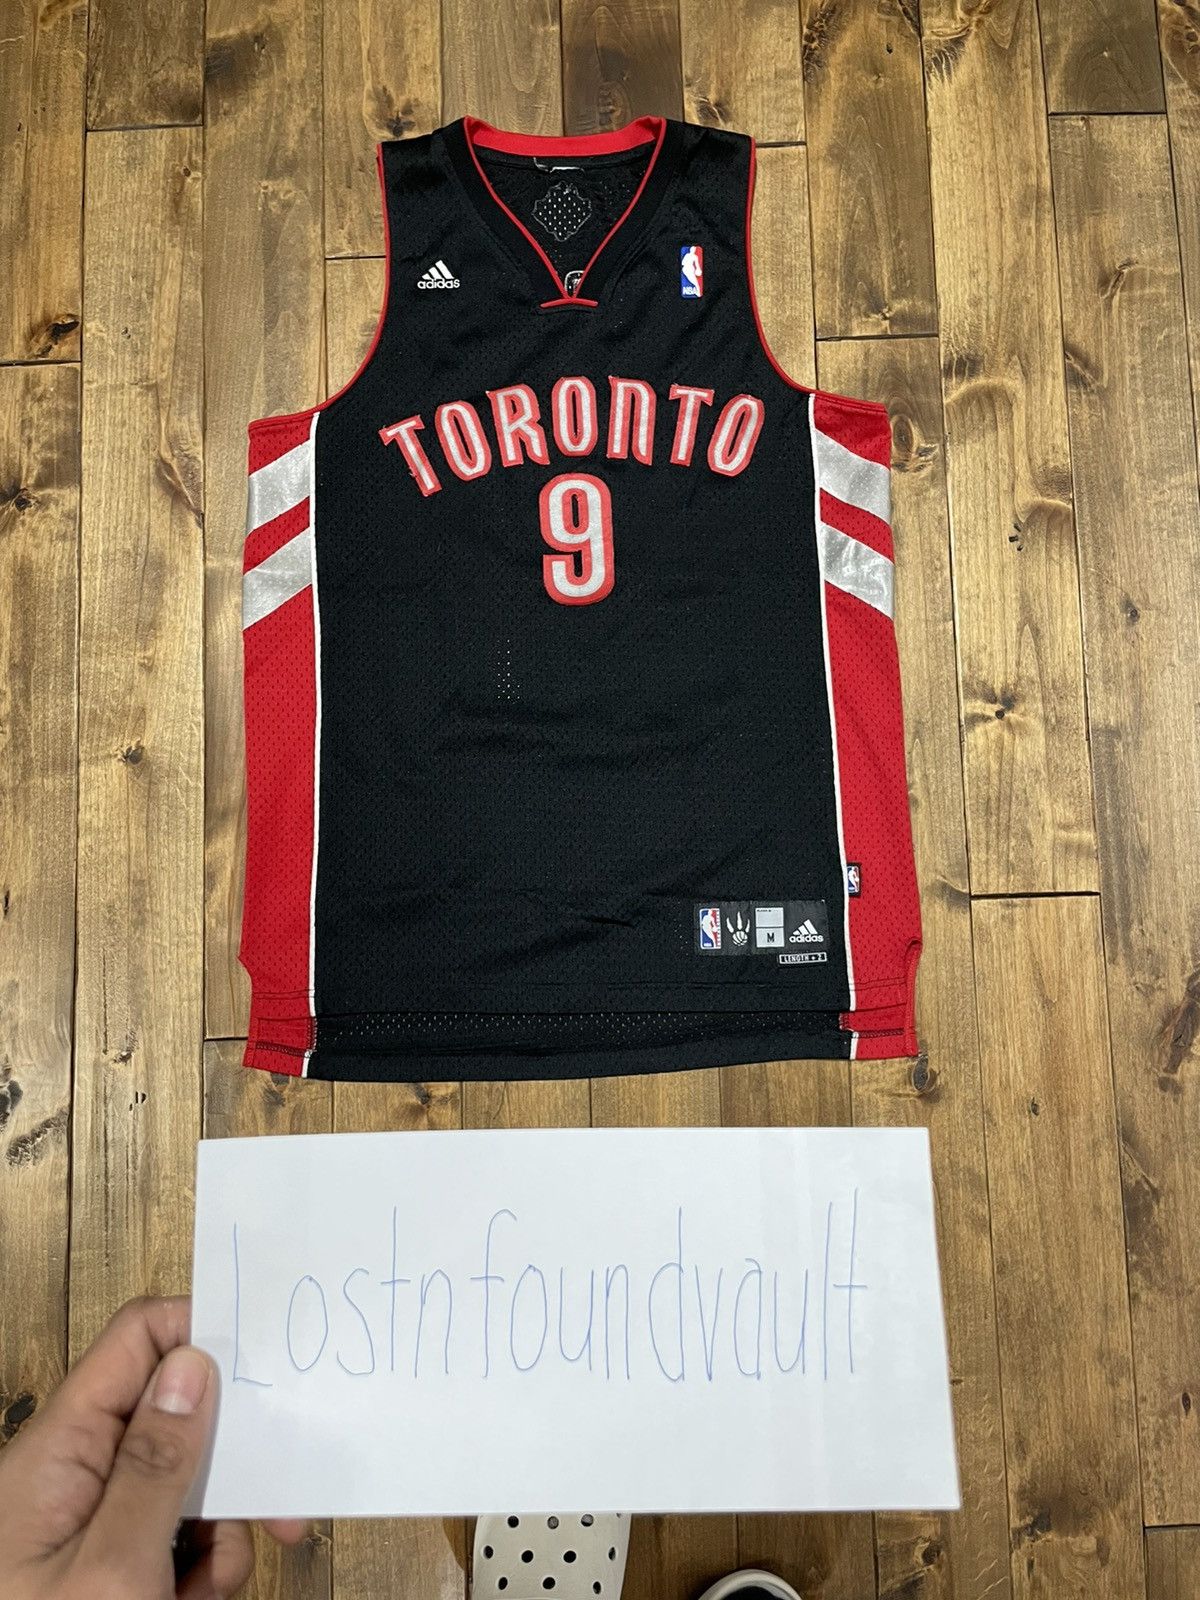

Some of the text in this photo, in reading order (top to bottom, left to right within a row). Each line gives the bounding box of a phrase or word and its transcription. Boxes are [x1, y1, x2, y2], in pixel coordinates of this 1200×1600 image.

[417, 278, 460, 289] adidas
[682, 286, 697, 295] NBA
[378, 376, 766, 497] TORONTO
[539, 473, 615, 606] 9
[766, 932, 775, 943] M
[789, 934, 824, 943] adidas
[232, 1187, 868, 1387] Lostnfoundvault
